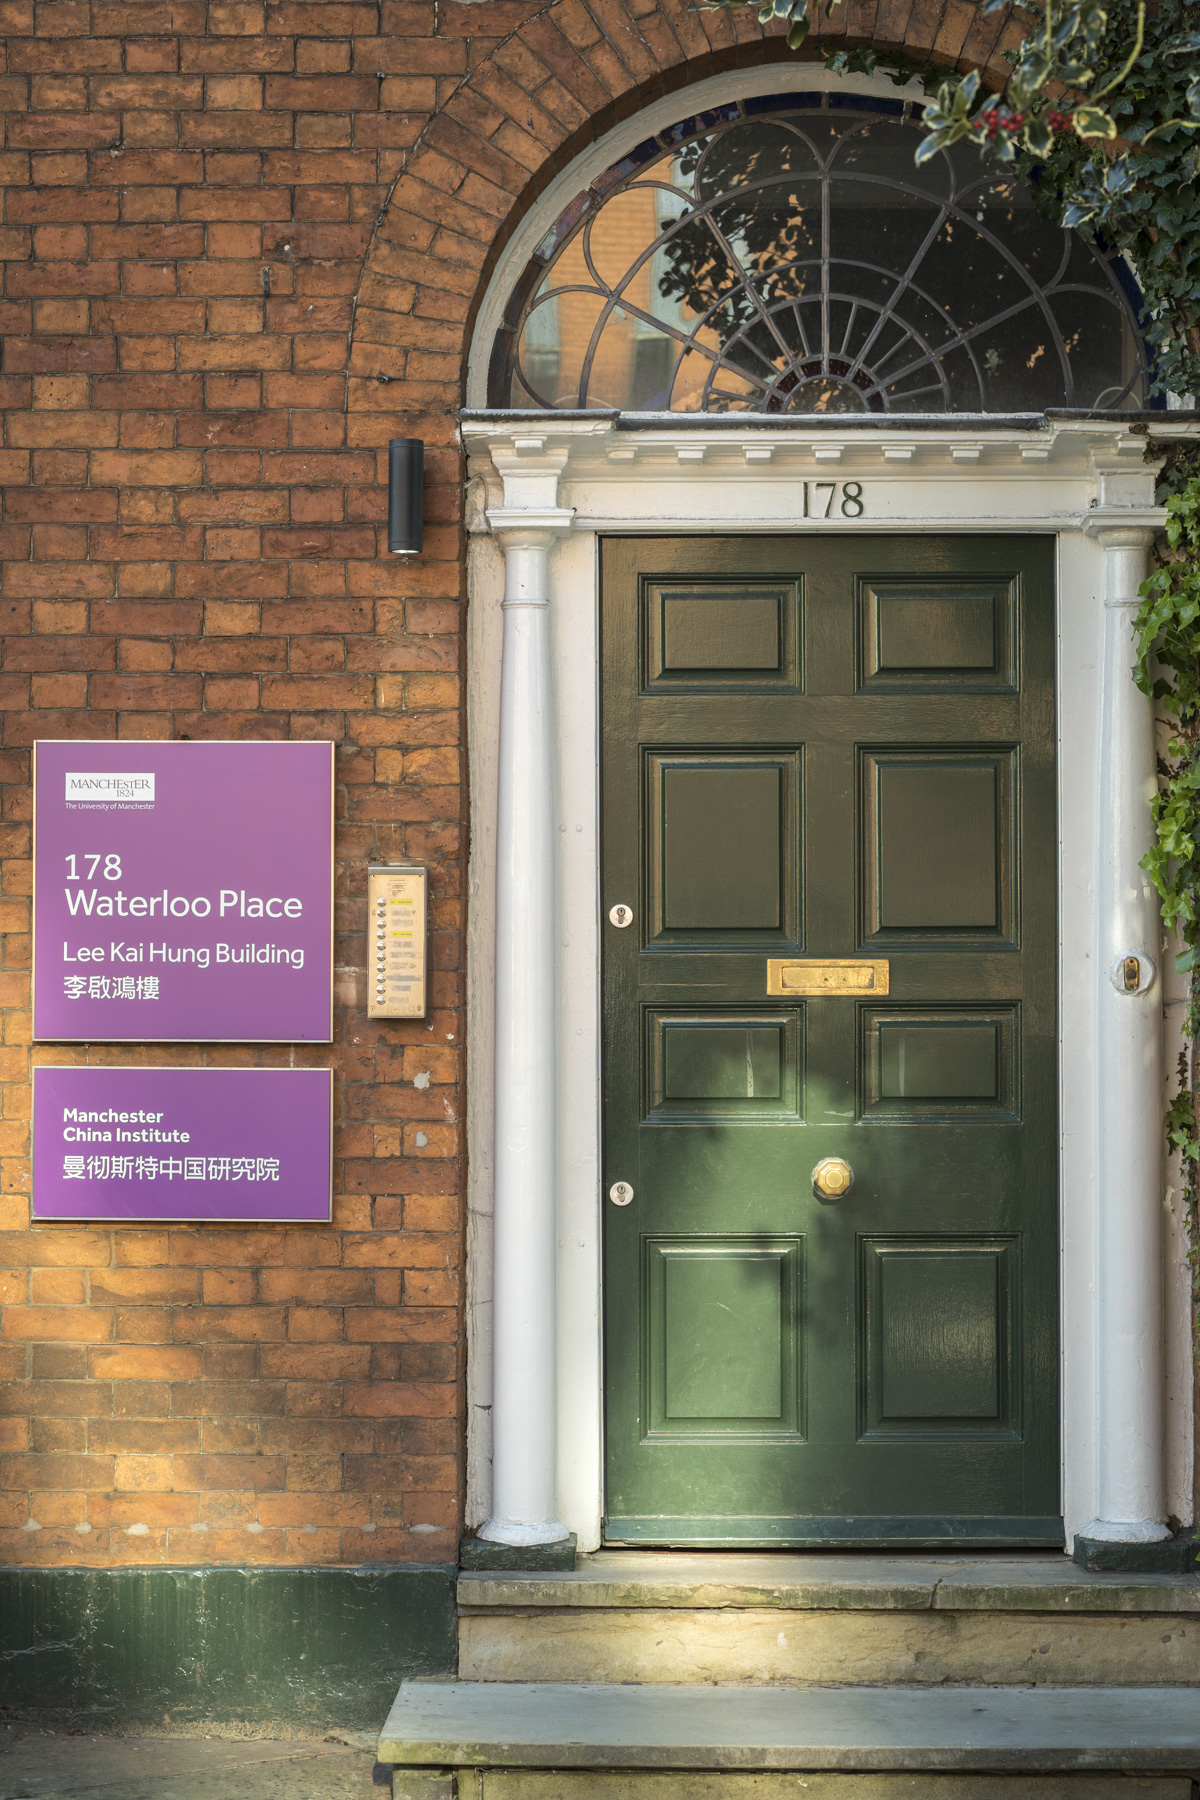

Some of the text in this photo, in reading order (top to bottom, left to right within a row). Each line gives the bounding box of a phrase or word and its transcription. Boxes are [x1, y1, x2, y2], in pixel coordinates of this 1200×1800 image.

[803, 481, 864, 518] 178
[70, 779, 151, 789] MANCHESTER
[116, 789, 134, 798] 1824
[65, 802, 155, 811] The University of Manchester
[64, 854, 123, 881] 178
[64, 888, 303, 918] Waterloo Place
[63, 941, 305, 970] Lee Kai Hung Building
[63, 1107, 164, 1124] Manchester
[62, 1126, 191, 1144] China Institute
[62, 1155, 280, 1182] 曼彻斯特中国研究院
